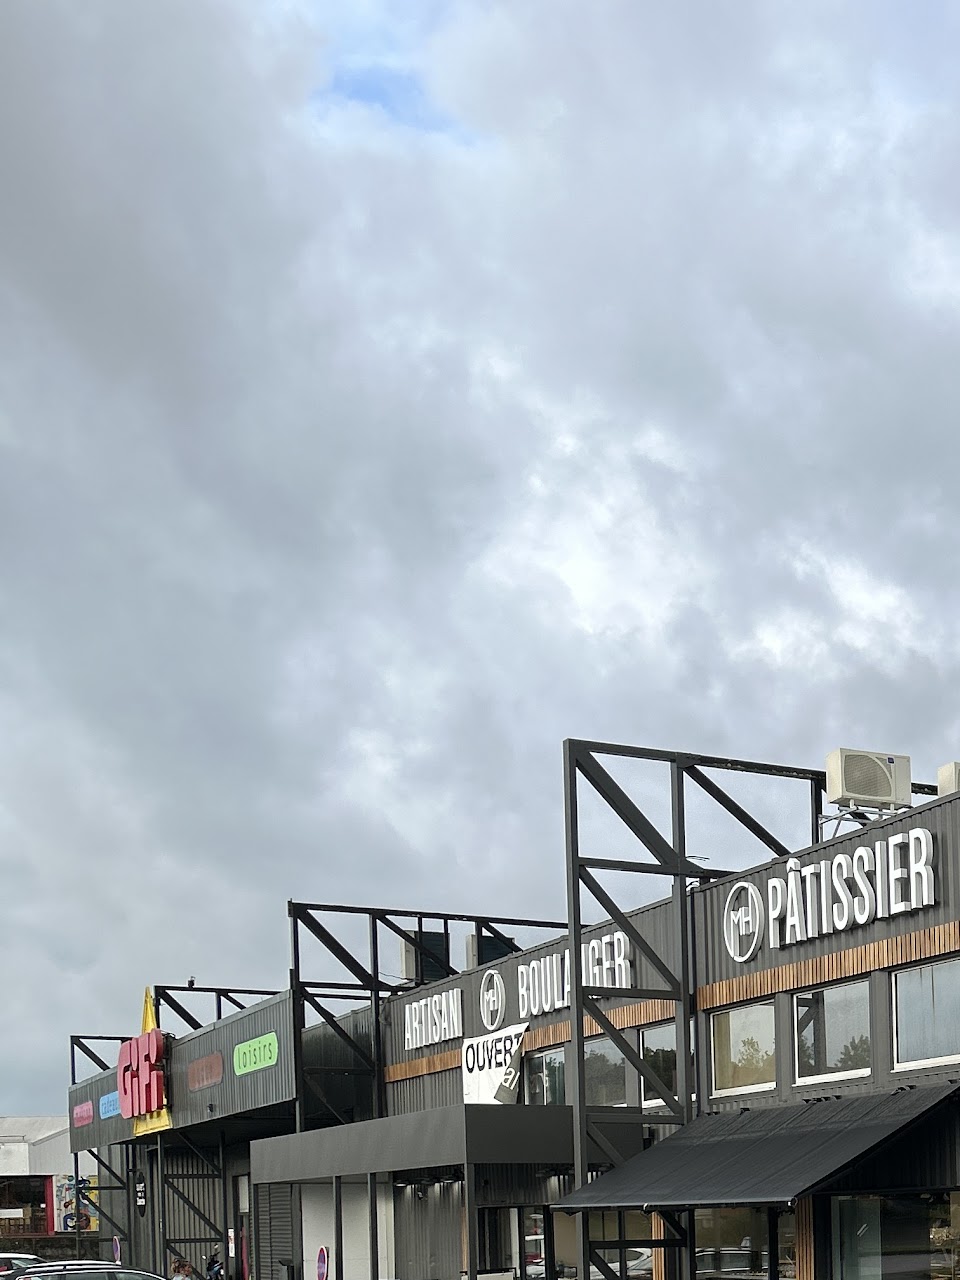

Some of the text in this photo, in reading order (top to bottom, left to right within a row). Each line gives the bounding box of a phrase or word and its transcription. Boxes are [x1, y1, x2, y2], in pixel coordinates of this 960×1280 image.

[404, 988, 463, 1050] ARTISAN
[768, 827, 934, 949] PÂTISSIER
[237, 1041, 273, 1070] loisirs
